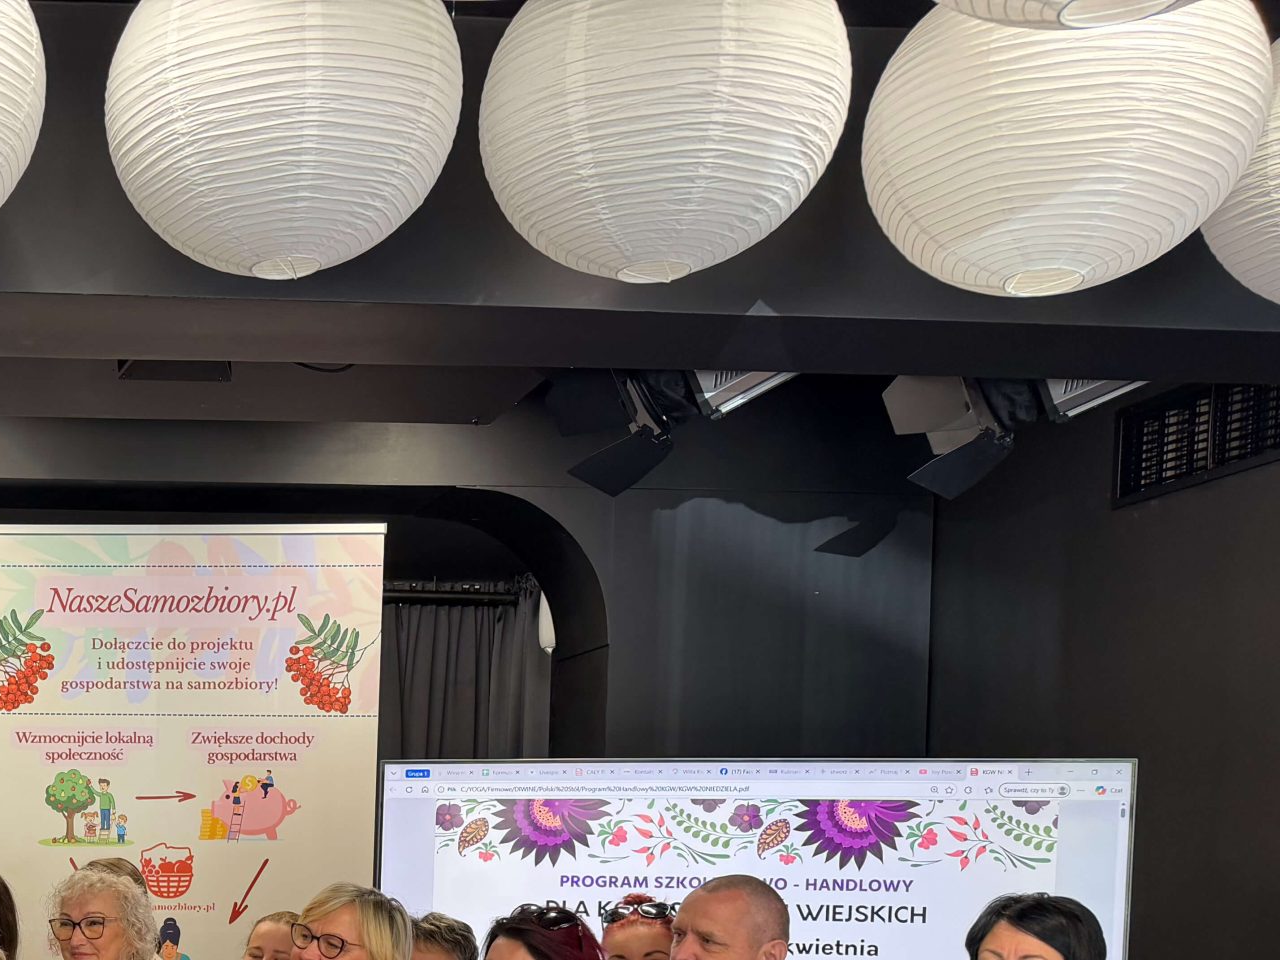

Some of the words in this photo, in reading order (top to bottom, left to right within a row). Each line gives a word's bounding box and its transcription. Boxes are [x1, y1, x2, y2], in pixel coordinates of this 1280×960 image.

[46, 586, 297, 621] NaszeSamozbiory.pl
[91, 637, 164, 653] Dołączcie
[167, 638, 186, 651] do
[189, 638, 253, 656] projektu
[106, 658, 207, 676] udostępnijcie
[210, 658, 251, 676] swoje
[61, 677, 161, 693] gospodarstwa
[166, 680, 183, 690] na
[187, 677, 278, 693] samozbiory!
[16, 731, 103, 746] Wzmocnijcie
[105, 731, 154, 746] lokalną
[191, 731, 253, 747] Zwiększe
[255, 731, 315, 747] dochody
[45, 748, 124, 764] społeczność
[207, 749, 297, 765] gospodarstwa
[560, 875, 649, 888] PROGRAM
[806, 878, 914, 892] HANDLOWY
[150, 902, 216, 913] amozbiory.pl
[796, 904, 927, 924] WIEJSKICH
